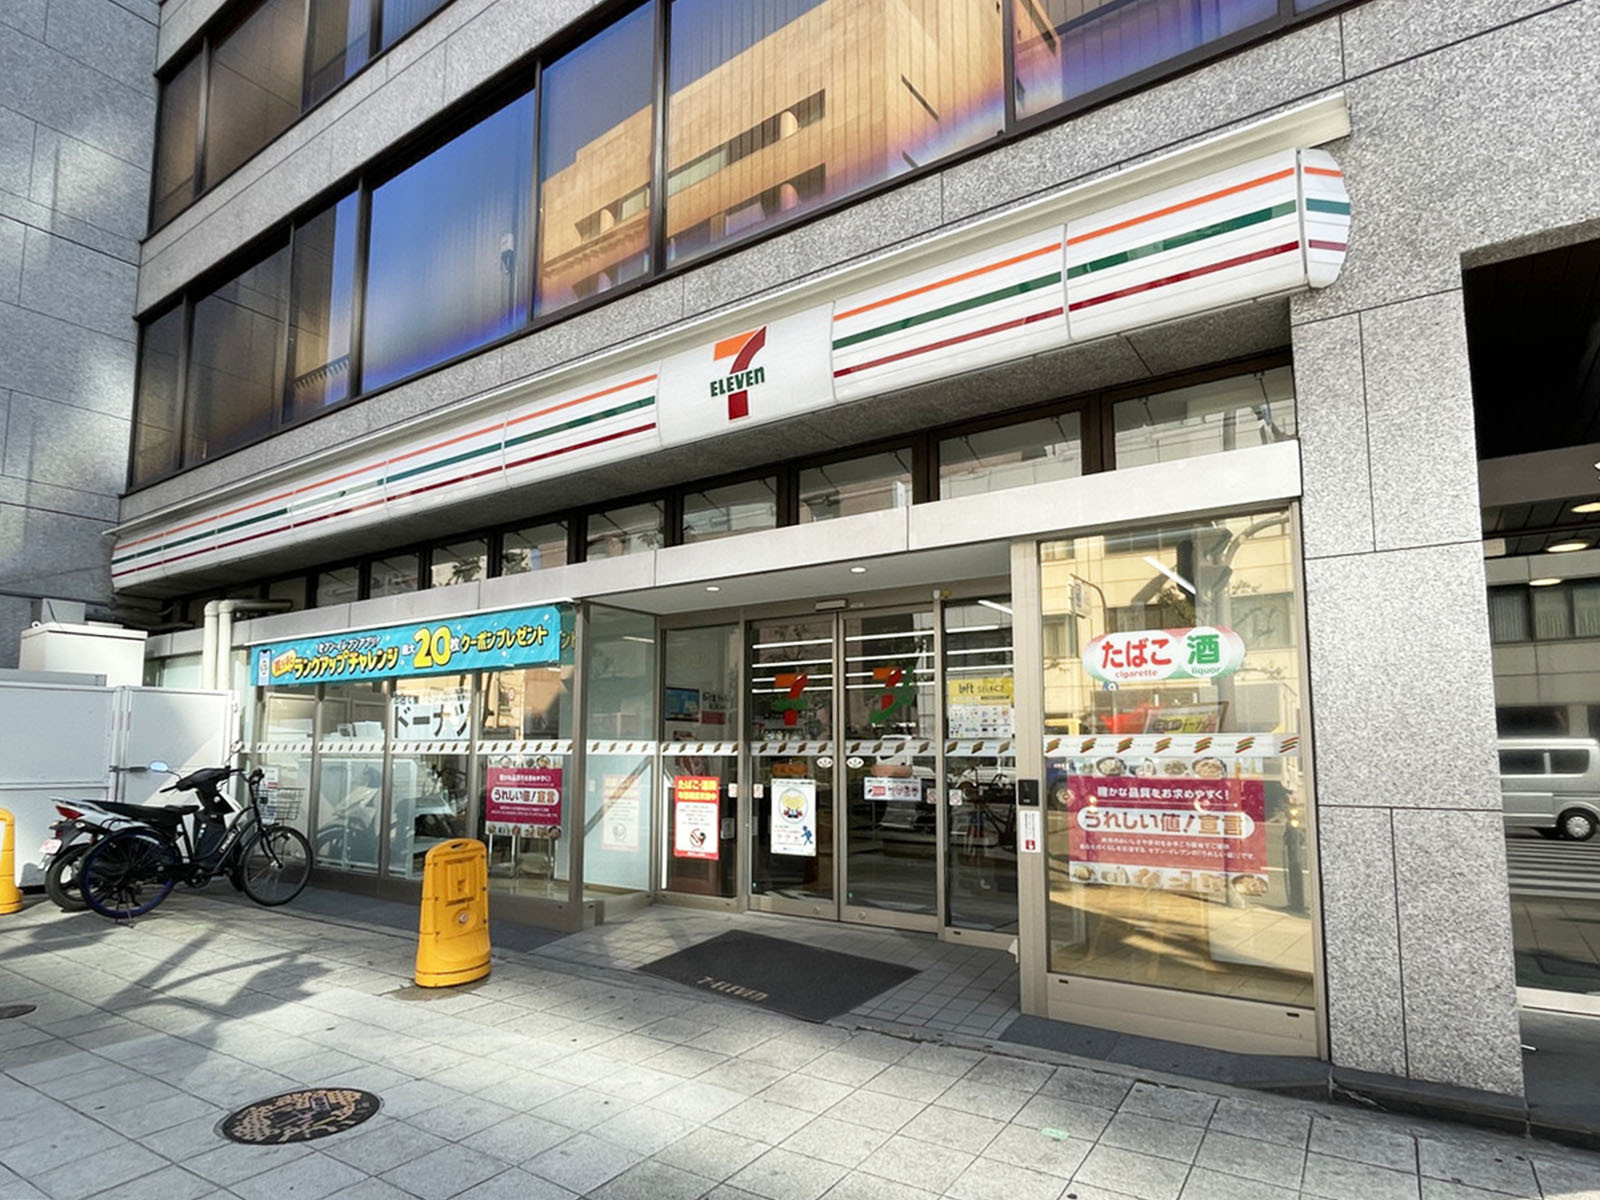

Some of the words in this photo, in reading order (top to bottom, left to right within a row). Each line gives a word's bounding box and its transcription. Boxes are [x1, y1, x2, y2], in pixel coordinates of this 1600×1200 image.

[295, 646, 399, 679] ランクアップチャレンジ
[1102, 637, 1172, 669] たばこ
[1187, 633, 1220, 665] 酒
[1115, 669, 1159, 679] cigarette
[1191, 667, 1222, 675] liquor
[395, 704, 471, 738] ドーナツ
